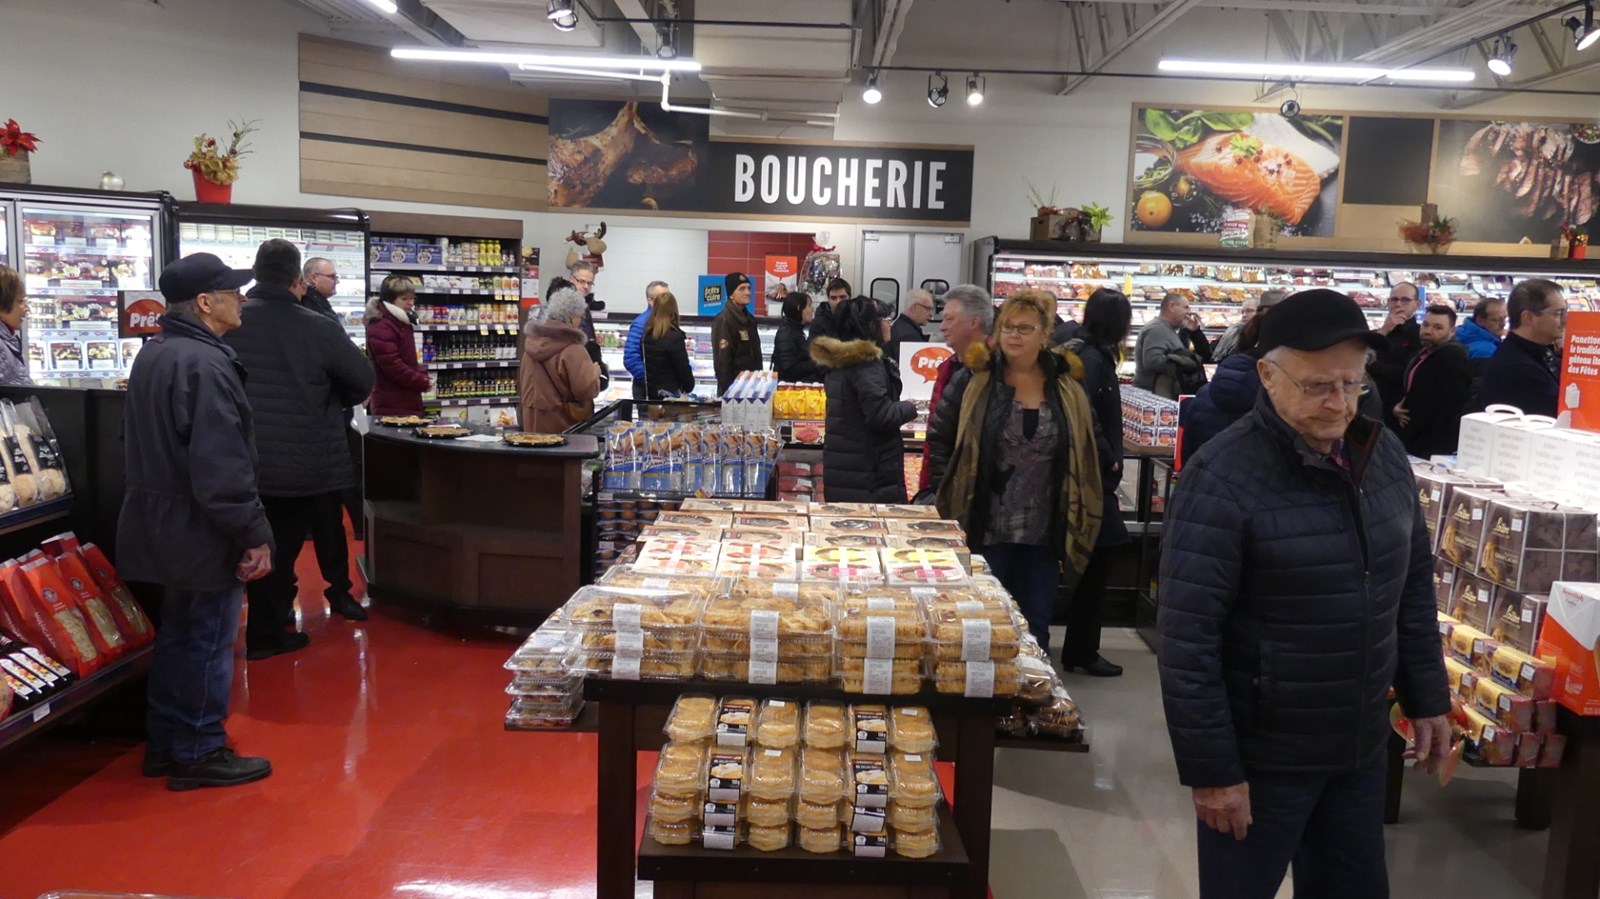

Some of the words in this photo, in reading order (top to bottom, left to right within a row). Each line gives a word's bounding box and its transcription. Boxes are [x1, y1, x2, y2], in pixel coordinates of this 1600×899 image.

[734, 153, 947, 210] BOUCHERIE
[918, 356, 948, 369] Prê
[1567, 365, 1579, 374] des
[1580, 366, 1598, 375] Fêtes
